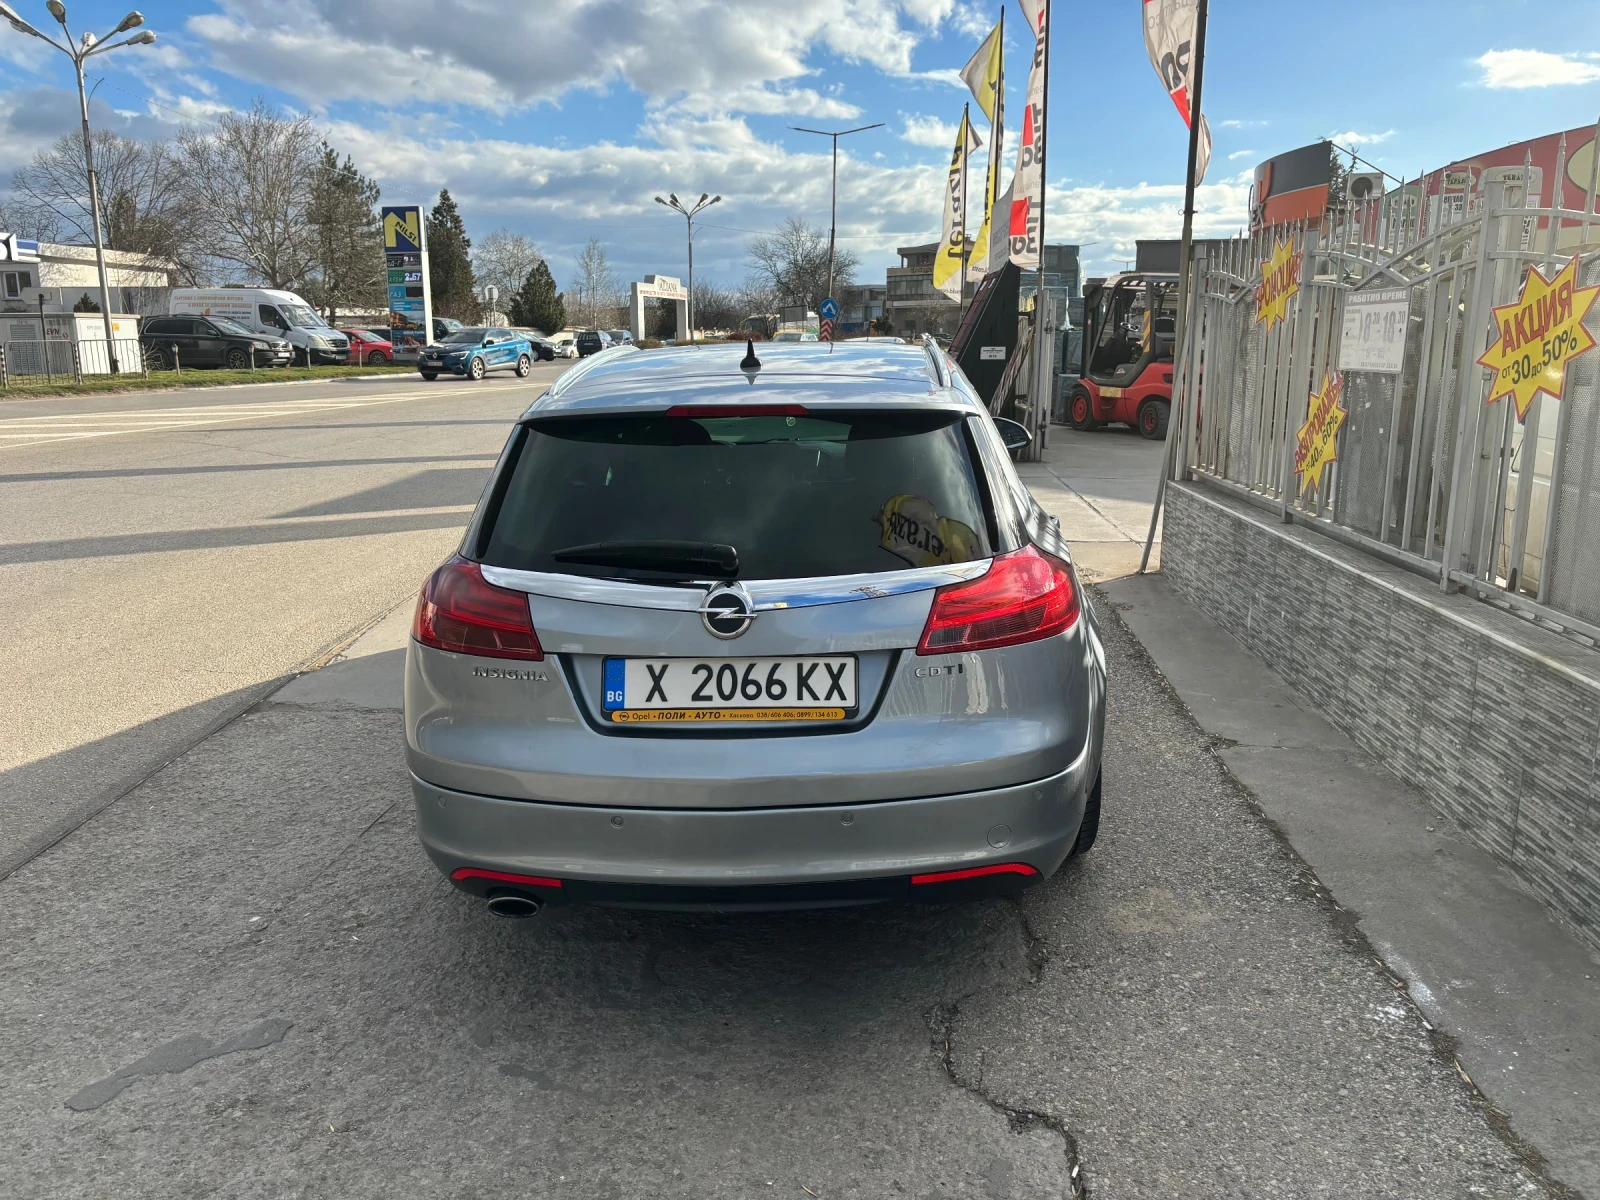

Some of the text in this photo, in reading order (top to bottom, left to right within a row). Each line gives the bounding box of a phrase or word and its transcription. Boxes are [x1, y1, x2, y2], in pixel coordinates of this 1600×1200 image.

[395, 221, 417, 242] NILSI
[404, 272, 421, 282] 2.57
[1348, 290, 1407, 304] РАБОТНО ВРЕМЕ
[1502, 279, 1573, 358] АКЦИЯ
[1511, 354, 1531, 385] 30
[1542, 325, 1578, 367] 50%
[1310, 446, 1319, 469] 40
[1321, 410, 1339, 446] 60%
[472, 666, 549, 682] INSIGNIA
[914, 663, 963, 678] CDTI
[645, 662, 848, 703] X 2066 KX
[606, 690, 624, 702] BG
[632, 713, 651, 721] Opel
[657, 711, 686, 720] ПОЛИ
[694, 711, 721, 720] АУТО
[756, 711, 781, 719] 038/606
[782, 711, 796, 719] 406;
